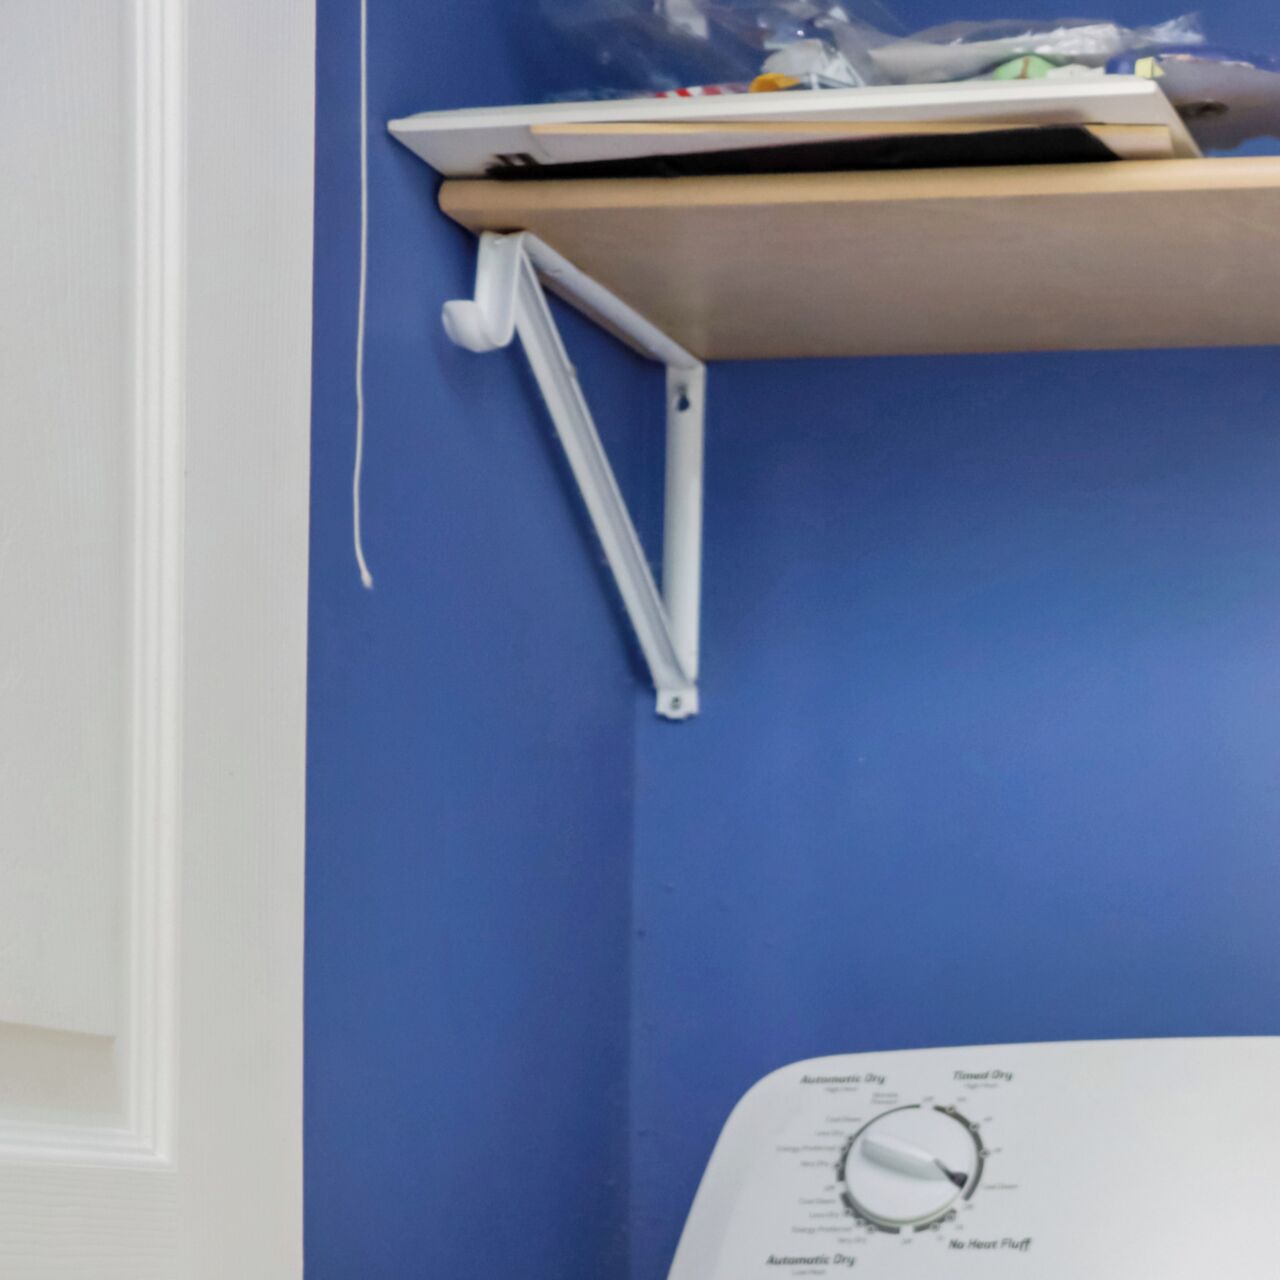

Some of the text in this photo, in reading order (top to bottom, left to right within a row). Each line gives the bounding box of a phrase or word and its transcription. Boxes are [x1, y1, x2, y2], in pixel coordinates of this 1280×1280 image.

[801, 1072, 886, 1085] Automatic Dry
[953, 1069, 1013, 1081] Timed Dry
[949, 1237, 1032, 1252] No Heat Fluff
[766, 1253, 856, 1267] Automatic Dry
